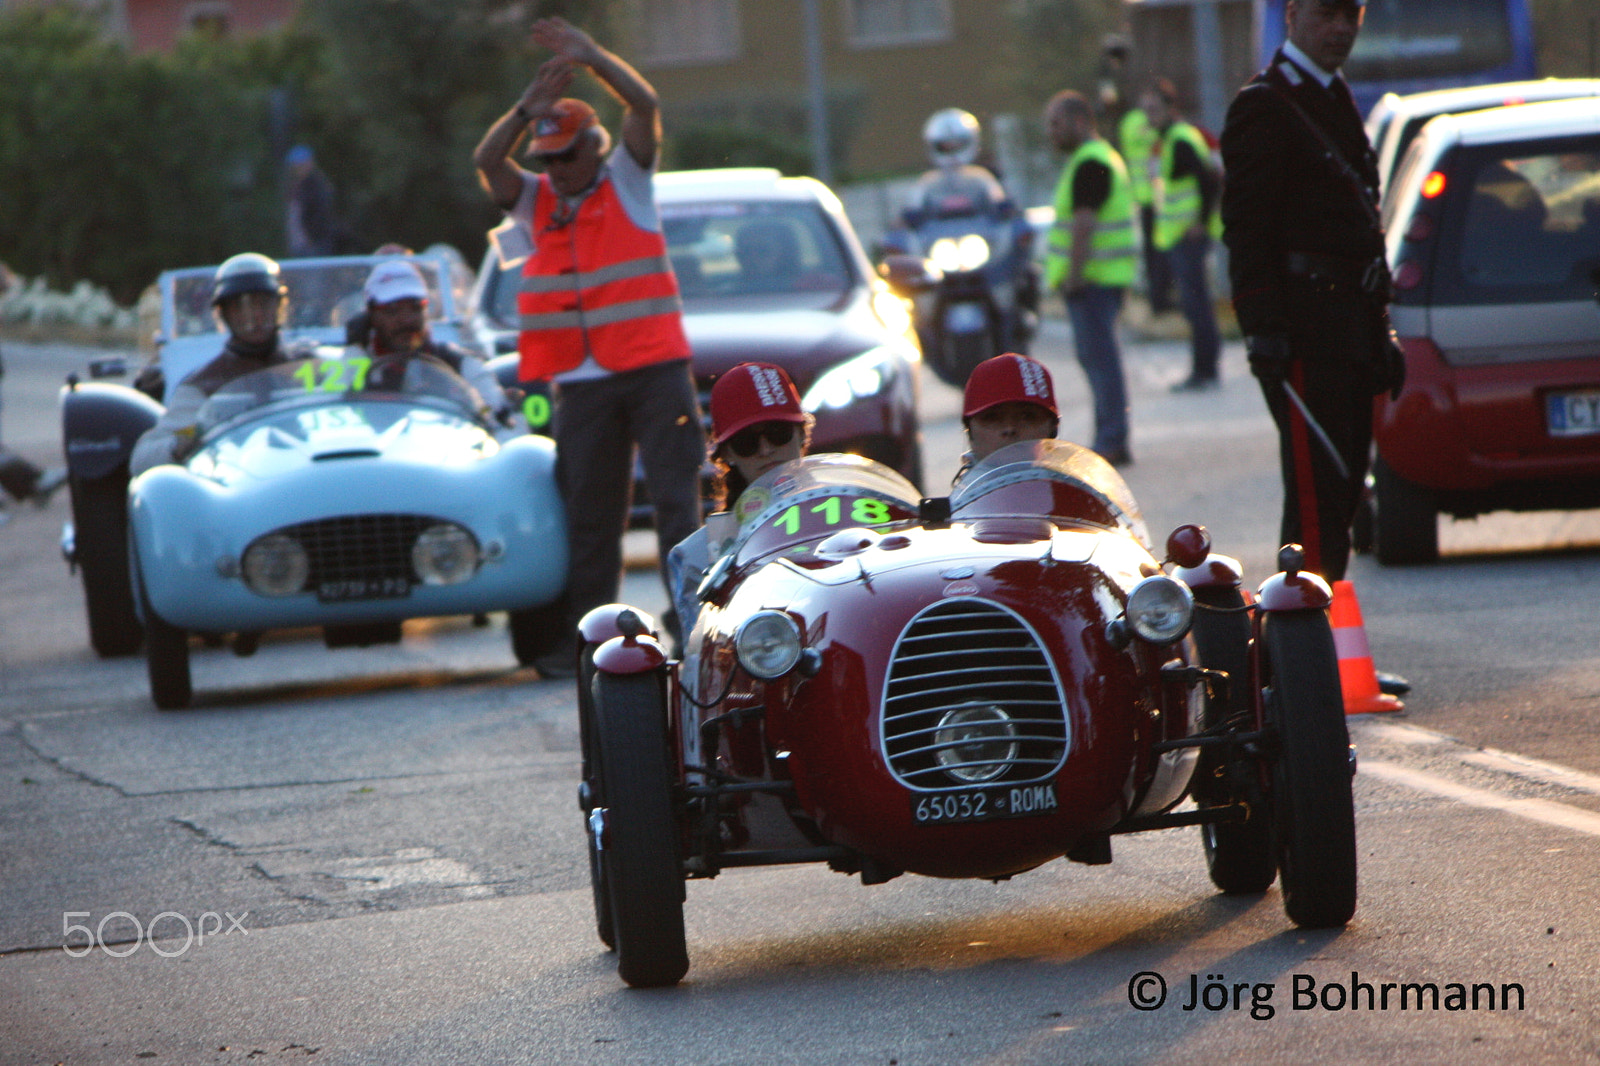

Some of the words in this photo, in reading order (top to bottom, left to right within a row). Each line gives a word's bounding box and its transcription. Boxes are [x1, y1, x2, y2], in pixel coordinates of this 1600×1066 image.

[294, 357, 371, 392] 127
[773, 496, 891, 535] 118
[916, 792, 987, 821] 65032
[1010, 785, 1058, 814] ROMA
